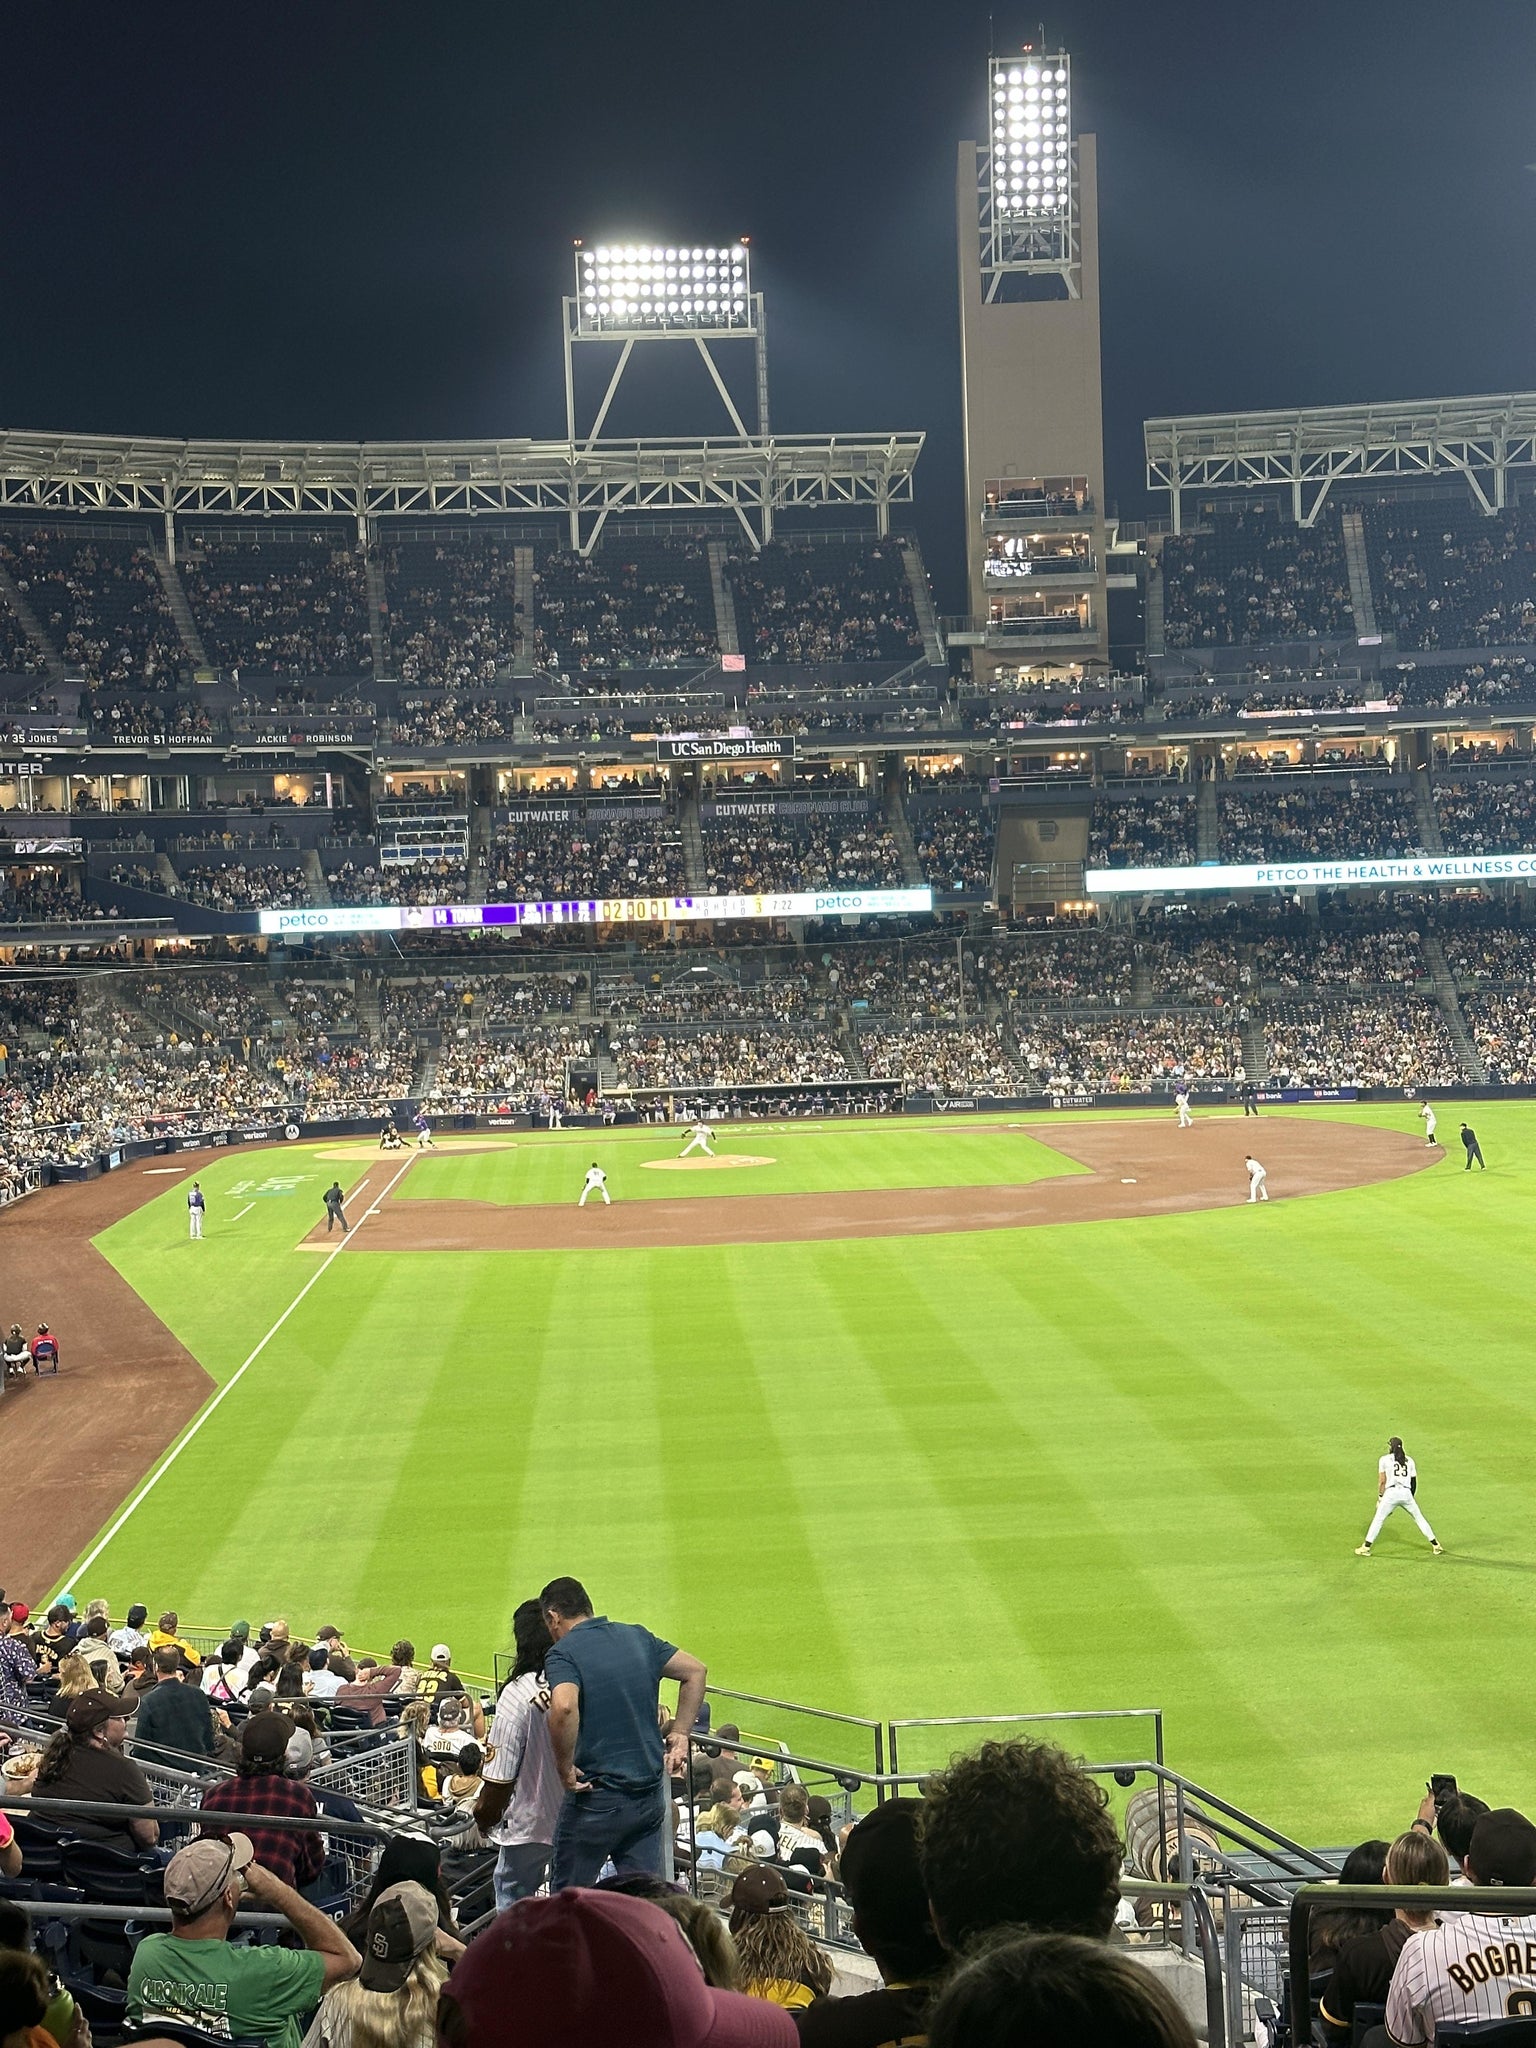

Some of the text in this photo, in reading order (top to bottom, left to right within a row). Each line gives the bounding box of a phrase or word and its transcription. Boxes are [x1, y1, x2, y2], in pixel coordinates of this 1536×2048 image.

[12, 733, 26, 744] 35
[28, 735, 58, 743] JONES
[112, 734, 213, 745] TREVOR 51 HOFFMAN
[255, 734, 353, 744] JACKIE 42 ROBINSON
[671, 739, 781, 756] UC San Diego Health
[715, 803, 776, 816] CUTWATER
[508, 809, 569, 823] CUTWATER
[1257, 868, 1308, 882] PETCO
[1313, 867, 1343, 879] THE
[1347, 864, 1408, 879] HEALTH
[1412, 864, 1423, 877] &
[1428, 859, 1513, 876] WELLNESS
[755, 902, 762, 914] 3
[773, 899, 792, 910] 7:22
[815, 895, 862, 912] petco
[613, 902, 622, 919] 2
[636, 901, 646, 919] 0
[661, 901, 668, 918] 1
[278, 912, 328, 929] petco
[1062, 1096, 1093, 1104] CUTWATER
[488, 1118, 515, 1126] verizon
[243, 1131, 268, 1140] verizon
[182, 1139, 201, 1148] verizon
[1393, 1463, 1408, 1477] 23
[432, 1741, 452, 1751] SOTO
[194, 1983, 228, 2010] ALE
